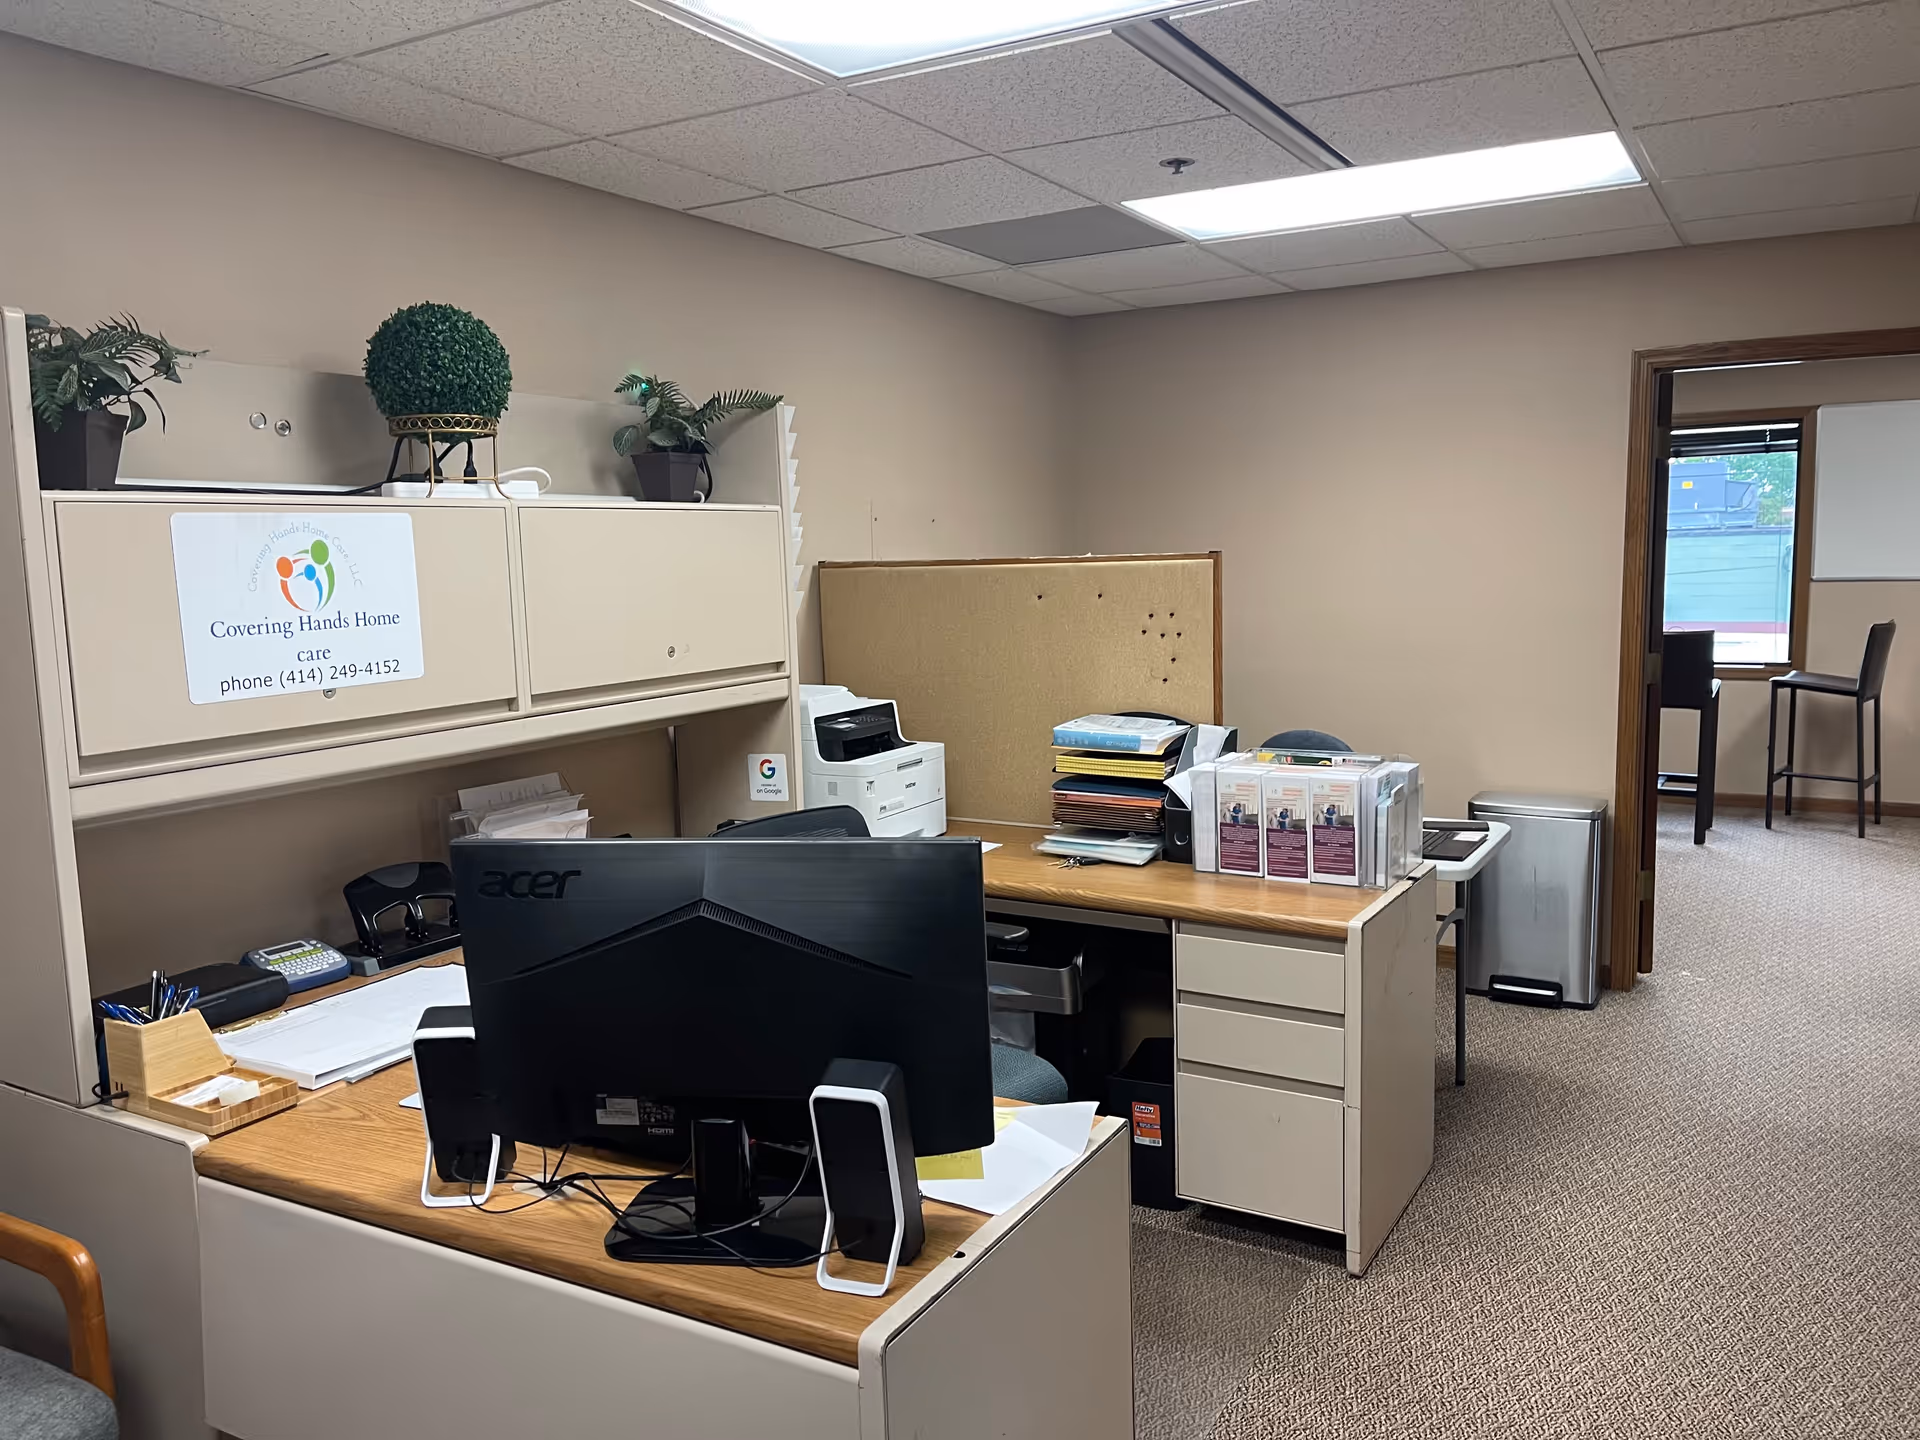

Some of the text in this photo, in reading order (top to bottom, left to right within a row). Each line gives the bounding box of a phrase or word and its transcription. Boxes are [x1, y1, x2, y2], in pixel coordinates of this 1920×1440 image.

[247, 543, 272, 592] Covering
[268, 521, 299, 544] Hands
[302, 521, 330, 540] Home
[210, 610, 401, 639] Covering Hands Home
[296, 645, 332, 662] care
[220, 658, 401, 696] phone (414) 249-4152
[764, 787, 782, 796] Google
[477, 869, 582, 899] acer
